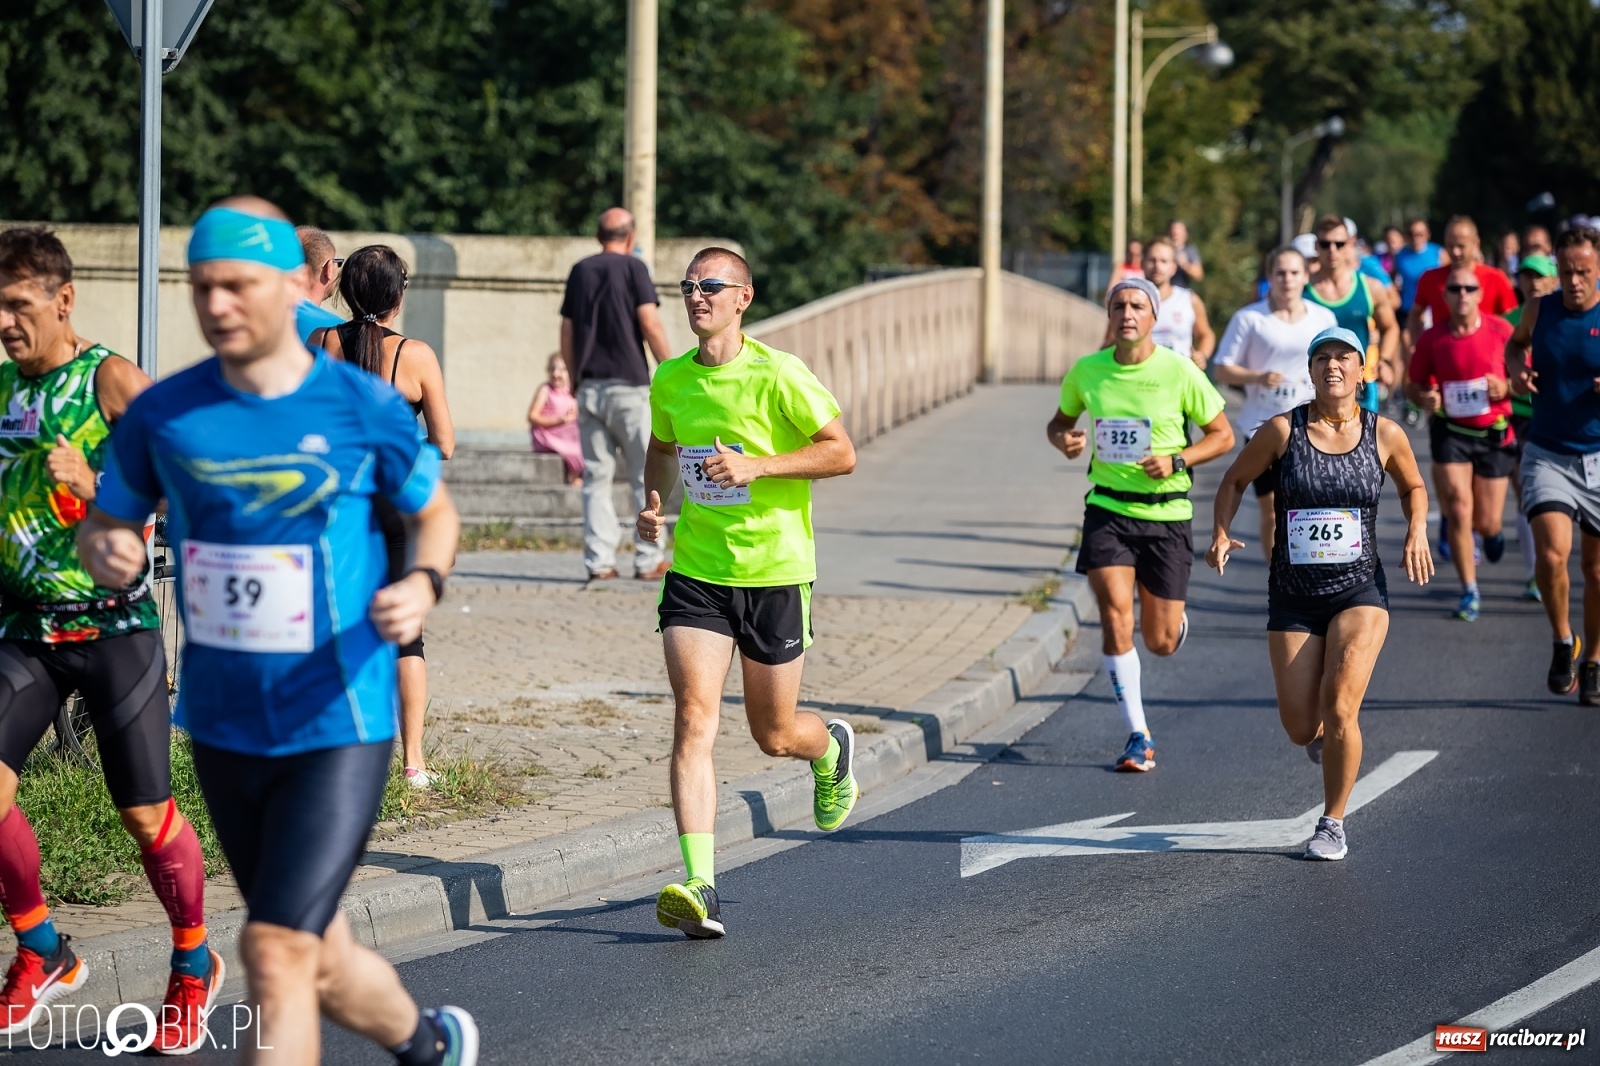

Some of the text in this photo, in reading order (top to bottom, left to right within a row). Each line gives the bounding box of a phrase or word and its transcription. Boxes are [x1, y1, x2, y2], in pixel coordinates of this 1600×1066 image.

[1111, 430, 1137, 445] 325
[1308, 523, 1343, 541] 265
[224, 575, 263, 607] 59
